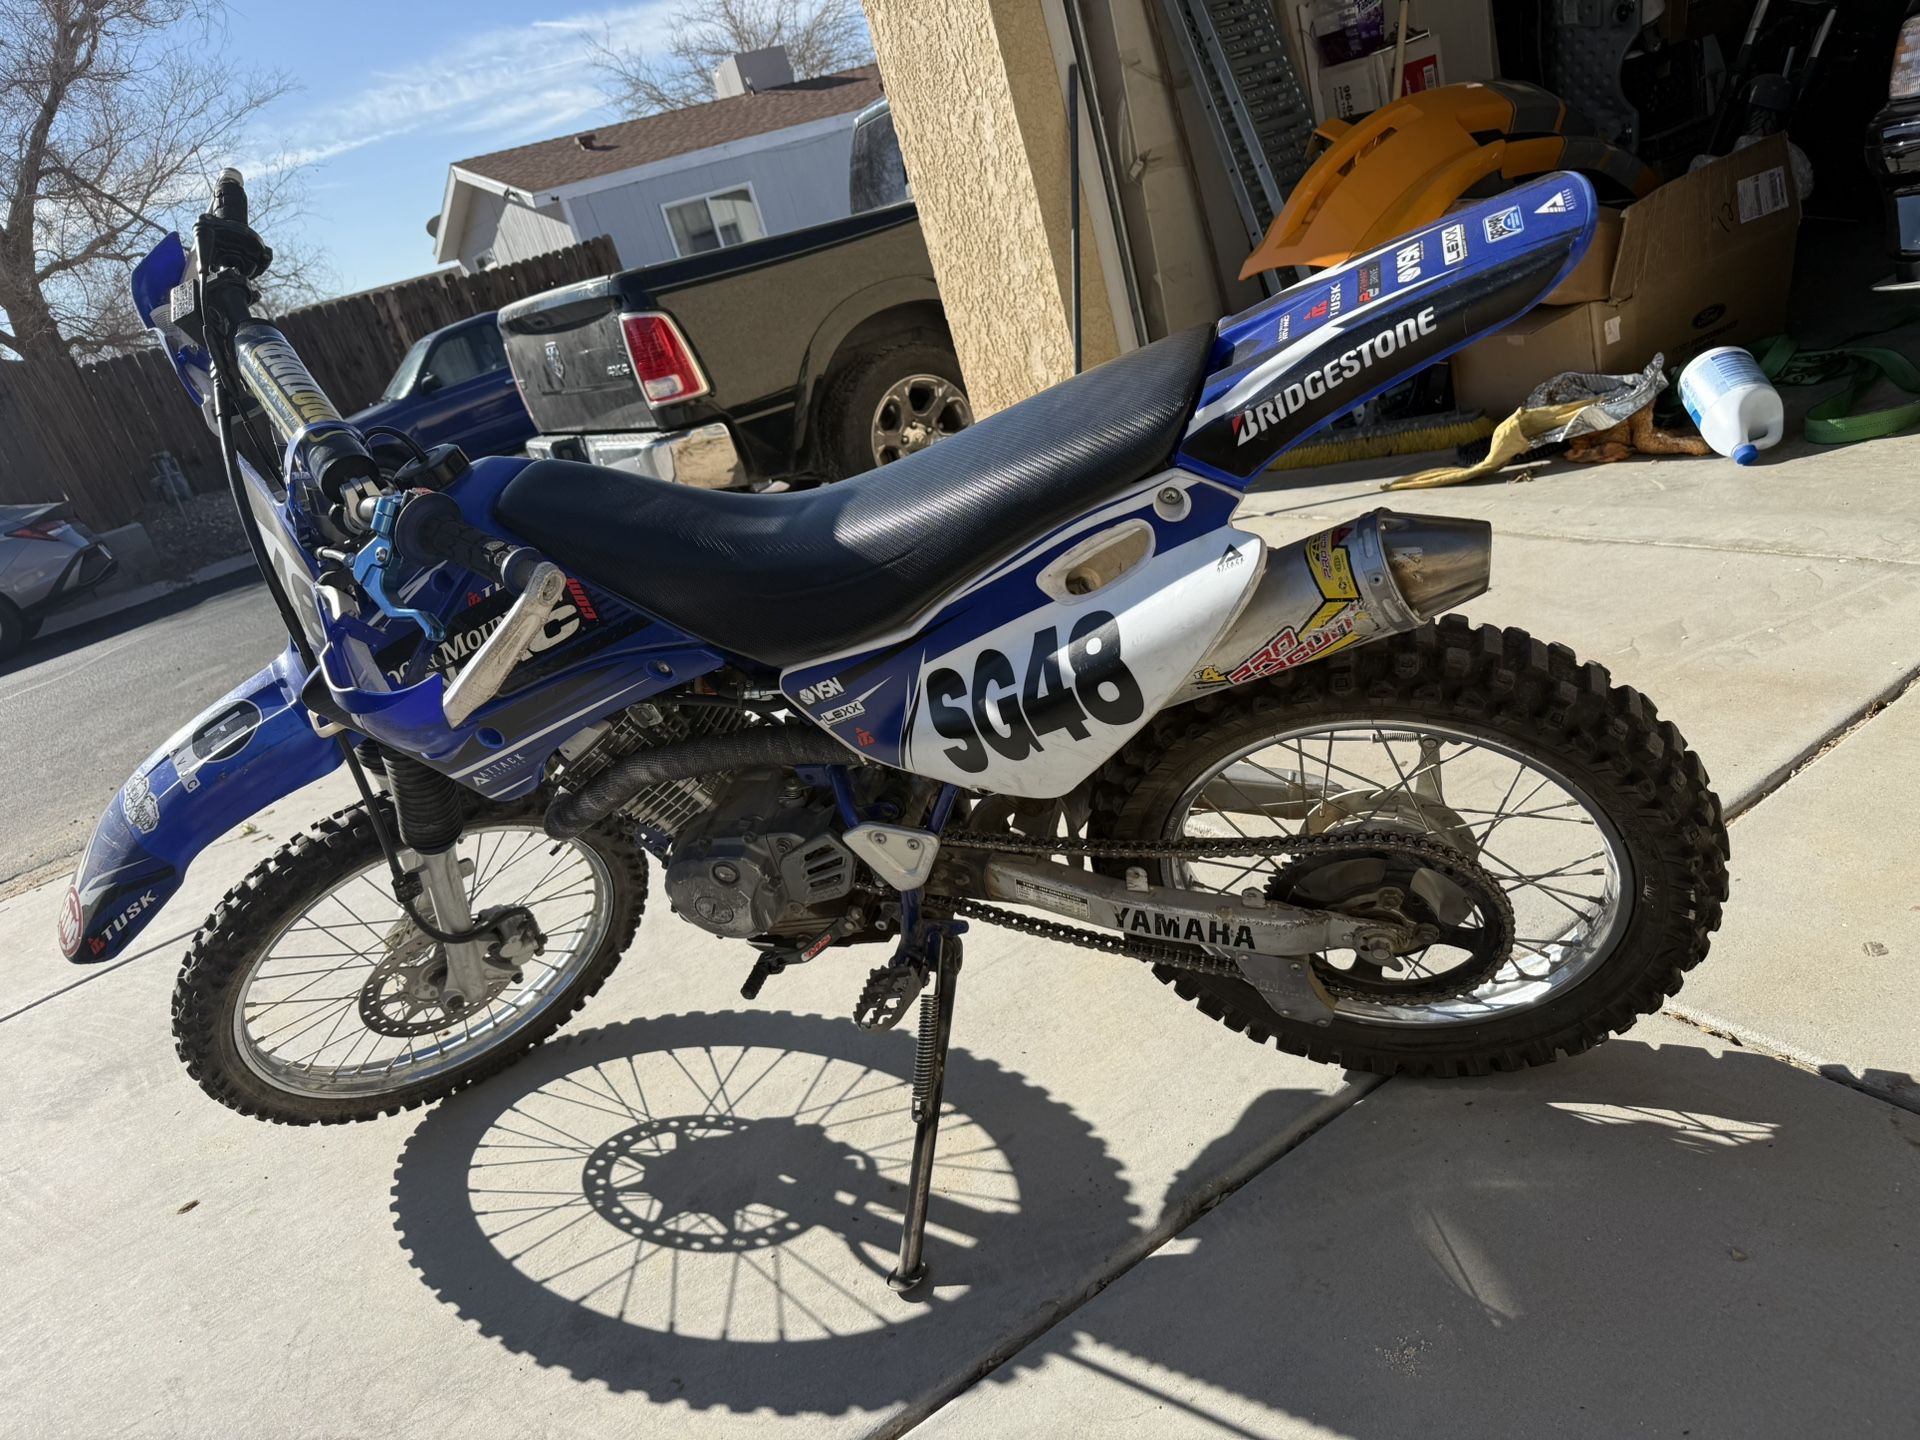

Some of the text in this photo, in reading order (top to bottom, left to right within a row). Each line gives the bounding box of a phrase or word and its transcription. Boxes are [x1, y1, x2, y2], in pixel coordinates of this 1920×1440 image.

[1445, 227, 1461, 263] LEXX
[1328, 283, 1341, 318] TUSK
[1232, 306, 1438, 447] BRIDGESTONE
[809, 676, 845, 700] VSN
[926, 610, 1145, 774] SG48
[823, 702, 862, 722] LEXX
[479, 753, 525, 779] ATTACK
[100, 889, 160, 941] TUSK
[1111, 907, 1256, 950] YAMAHA
